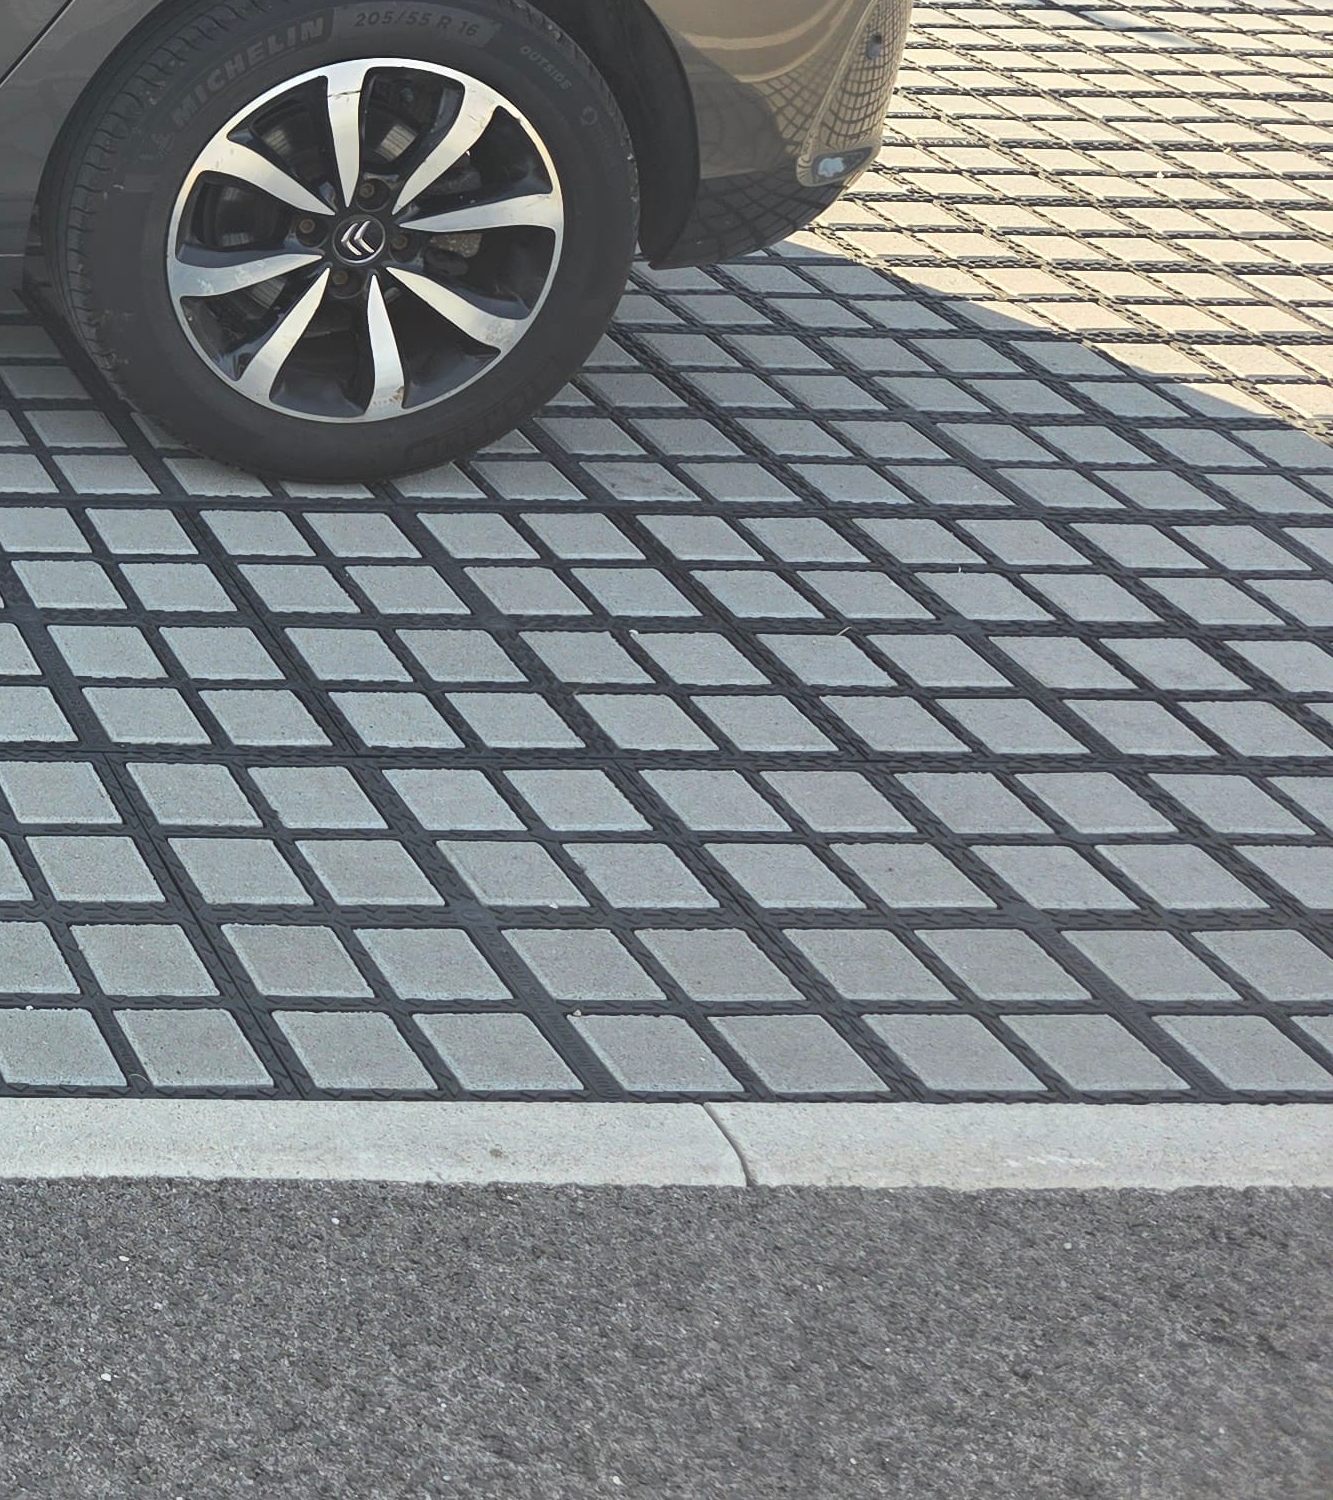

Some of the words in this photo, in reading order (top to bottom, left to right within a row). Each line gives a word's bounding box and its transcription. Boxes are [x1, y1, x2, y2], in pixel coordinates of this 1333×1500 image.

[354, 10, 432, 27] 205/55
[436, 15, 452, 29] R
[458, 20, 480, 36] 16
[170, 16, 325, 128] MICHELIN
[519, 45, 573, 90] OUTSIDE
